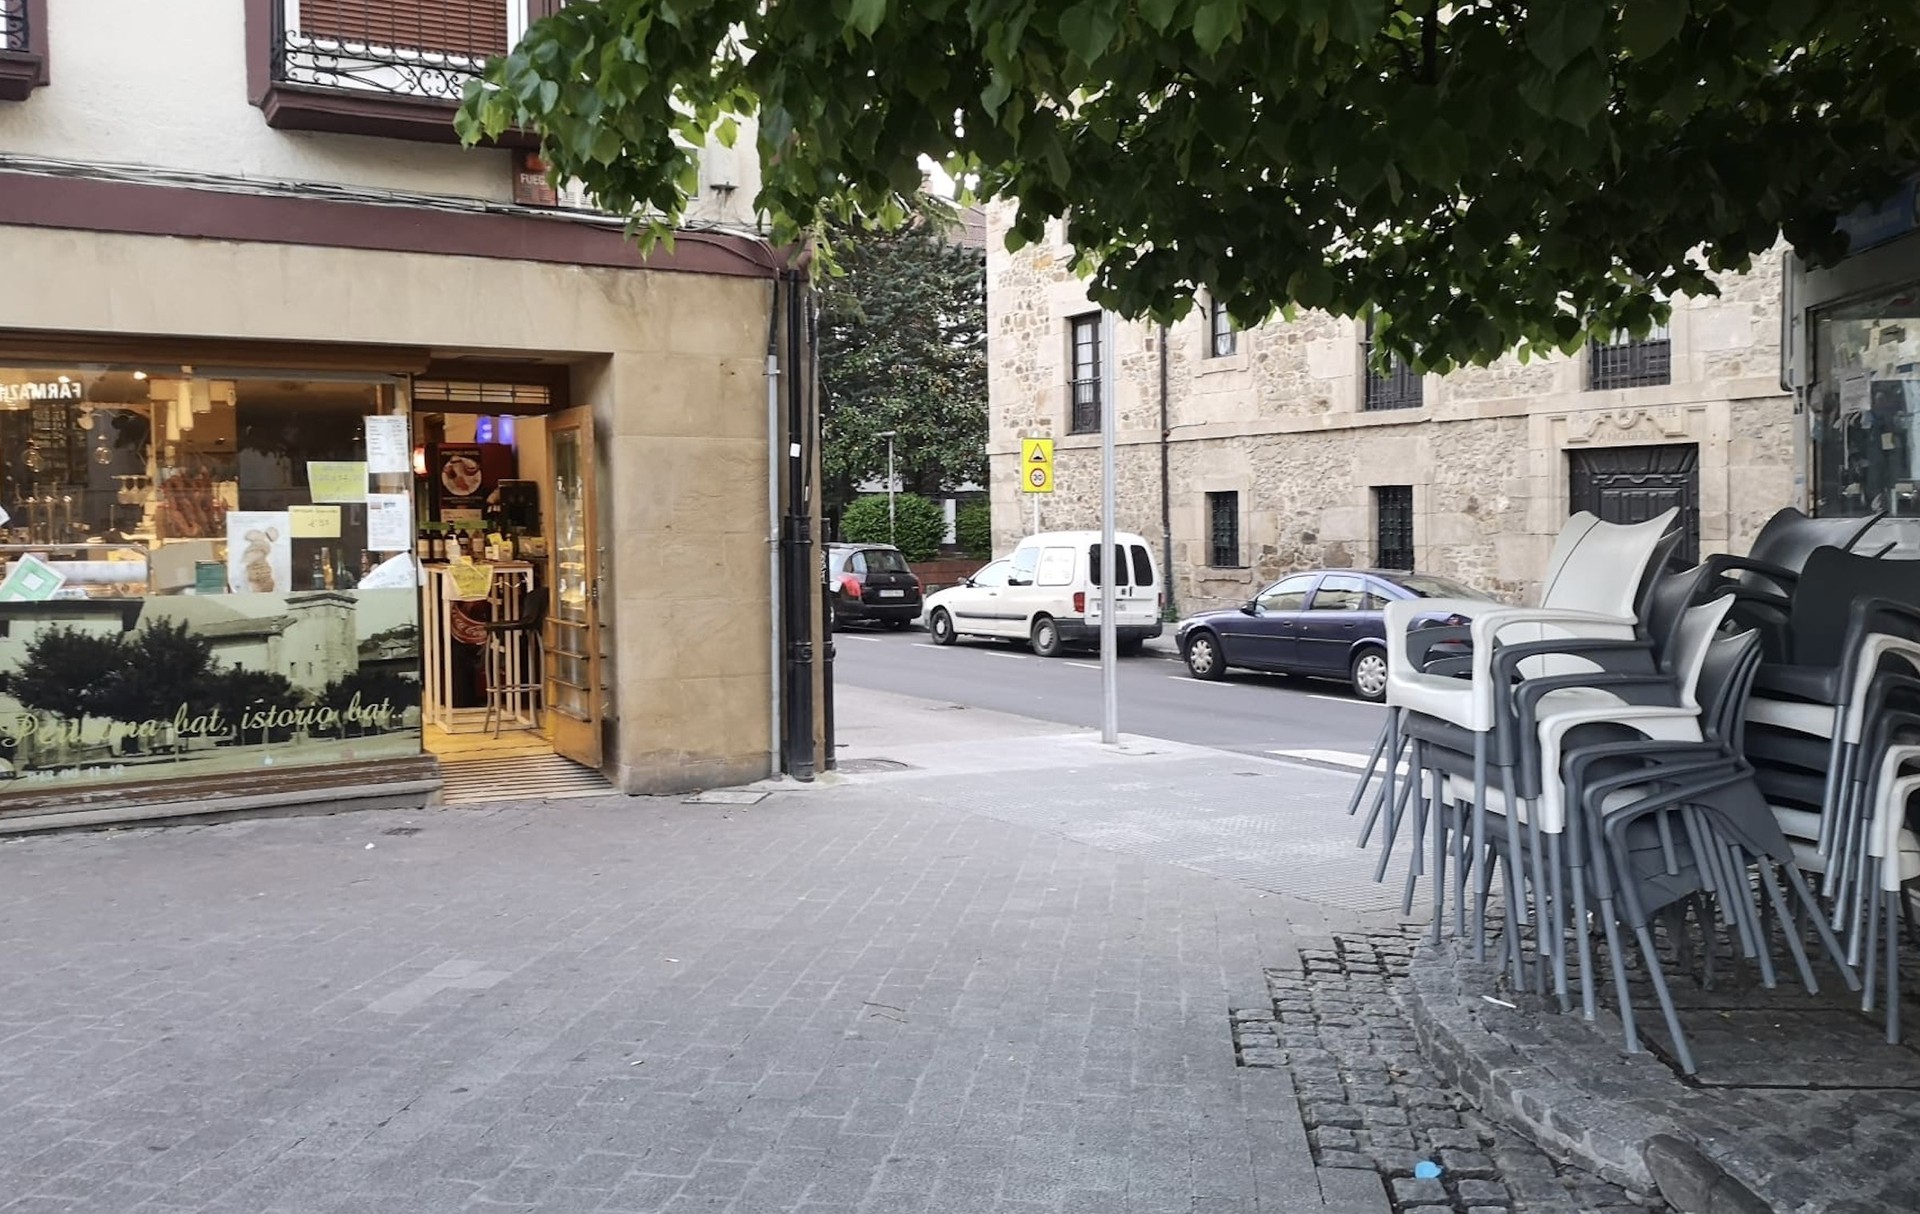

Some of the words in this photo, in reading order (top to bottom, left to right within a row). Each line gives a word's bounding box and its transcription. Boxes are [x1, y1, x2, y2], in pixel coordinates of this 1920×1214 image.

[520, 173, 547, 185] FUEG
[1033, 474, 1043, 482] 30
[173, 702, 229, 736] bat,
[241, 701, 338, 730] istorio
